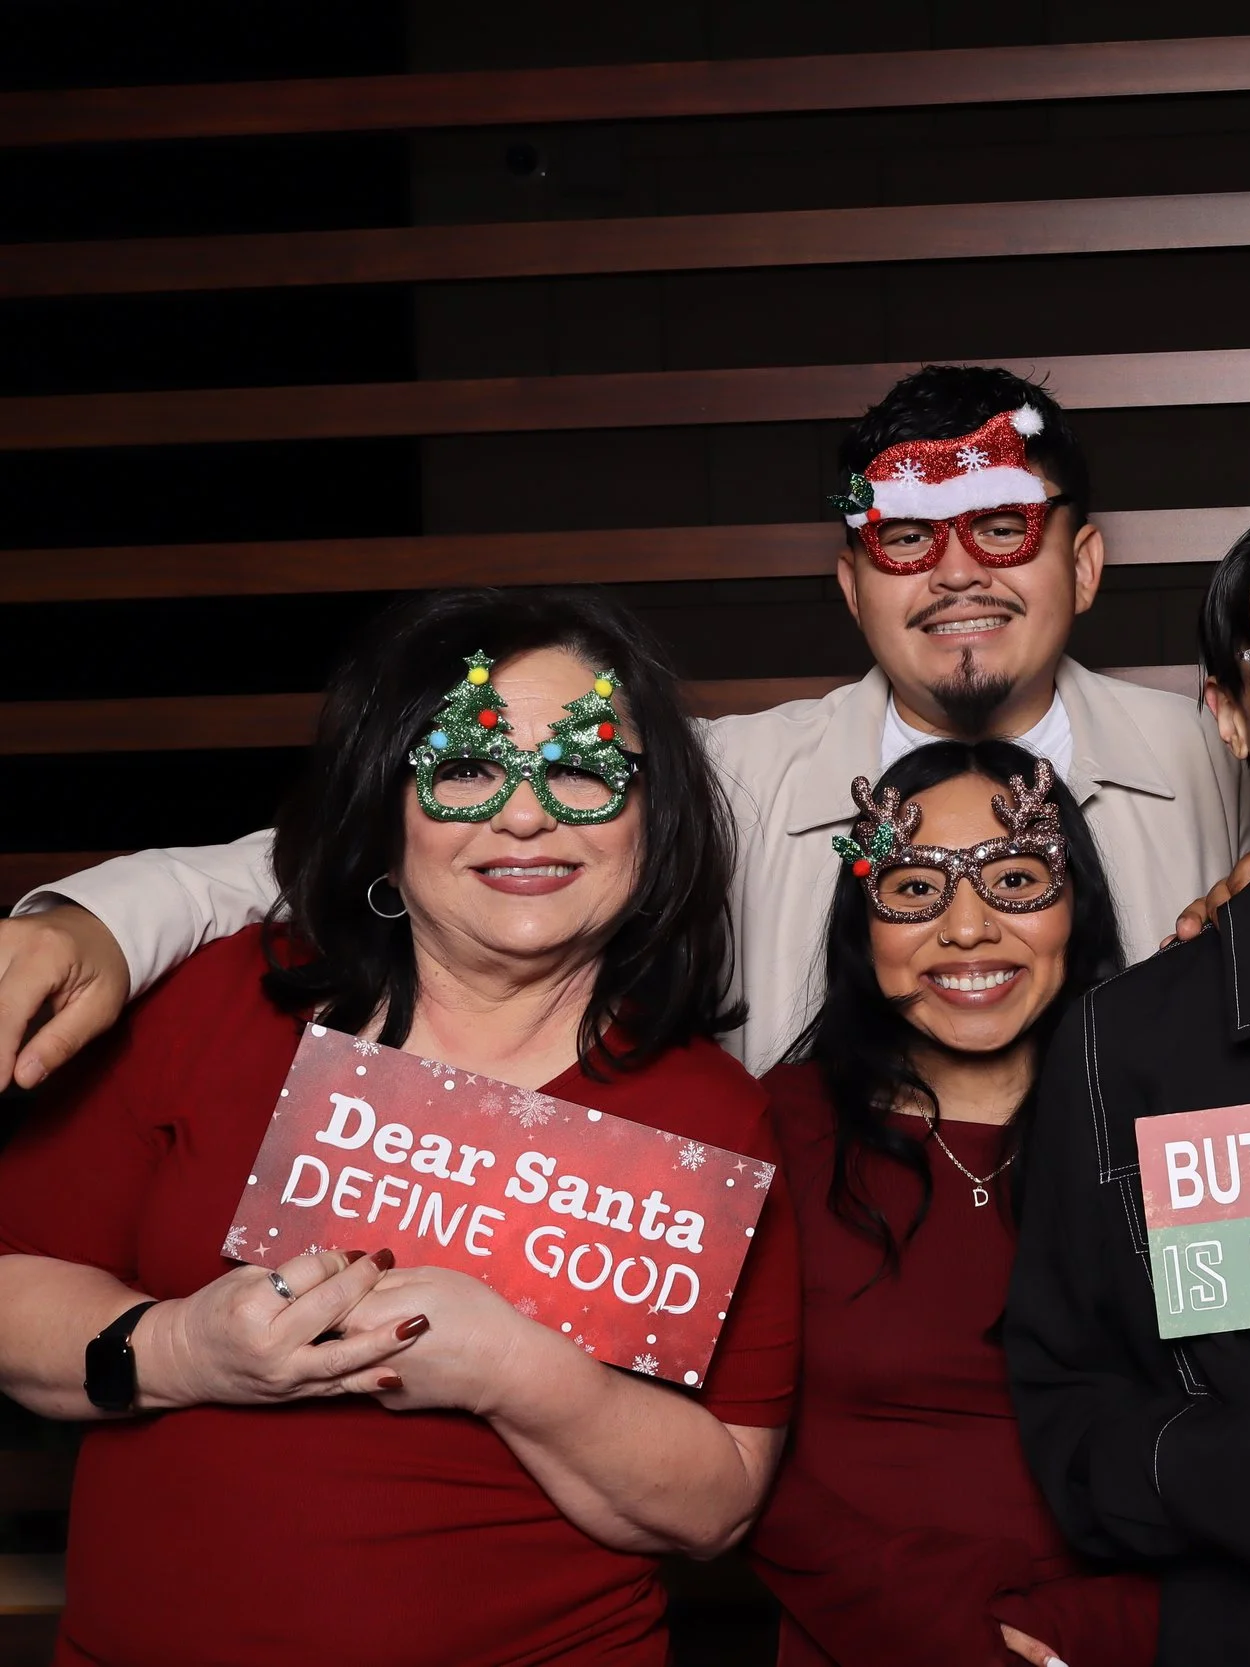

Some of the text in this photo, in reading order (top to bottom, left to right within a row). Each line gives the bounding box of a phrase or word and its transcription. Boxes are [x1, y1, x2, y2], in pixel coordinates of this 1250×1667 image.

[315, 1091, 706, 1254] Dear Santa
[972, 1188, 989, 1208] D
[280, 1153, 701, 1315] DEFINE GOOD
[1162, 1239, 1229, 1315] IS
